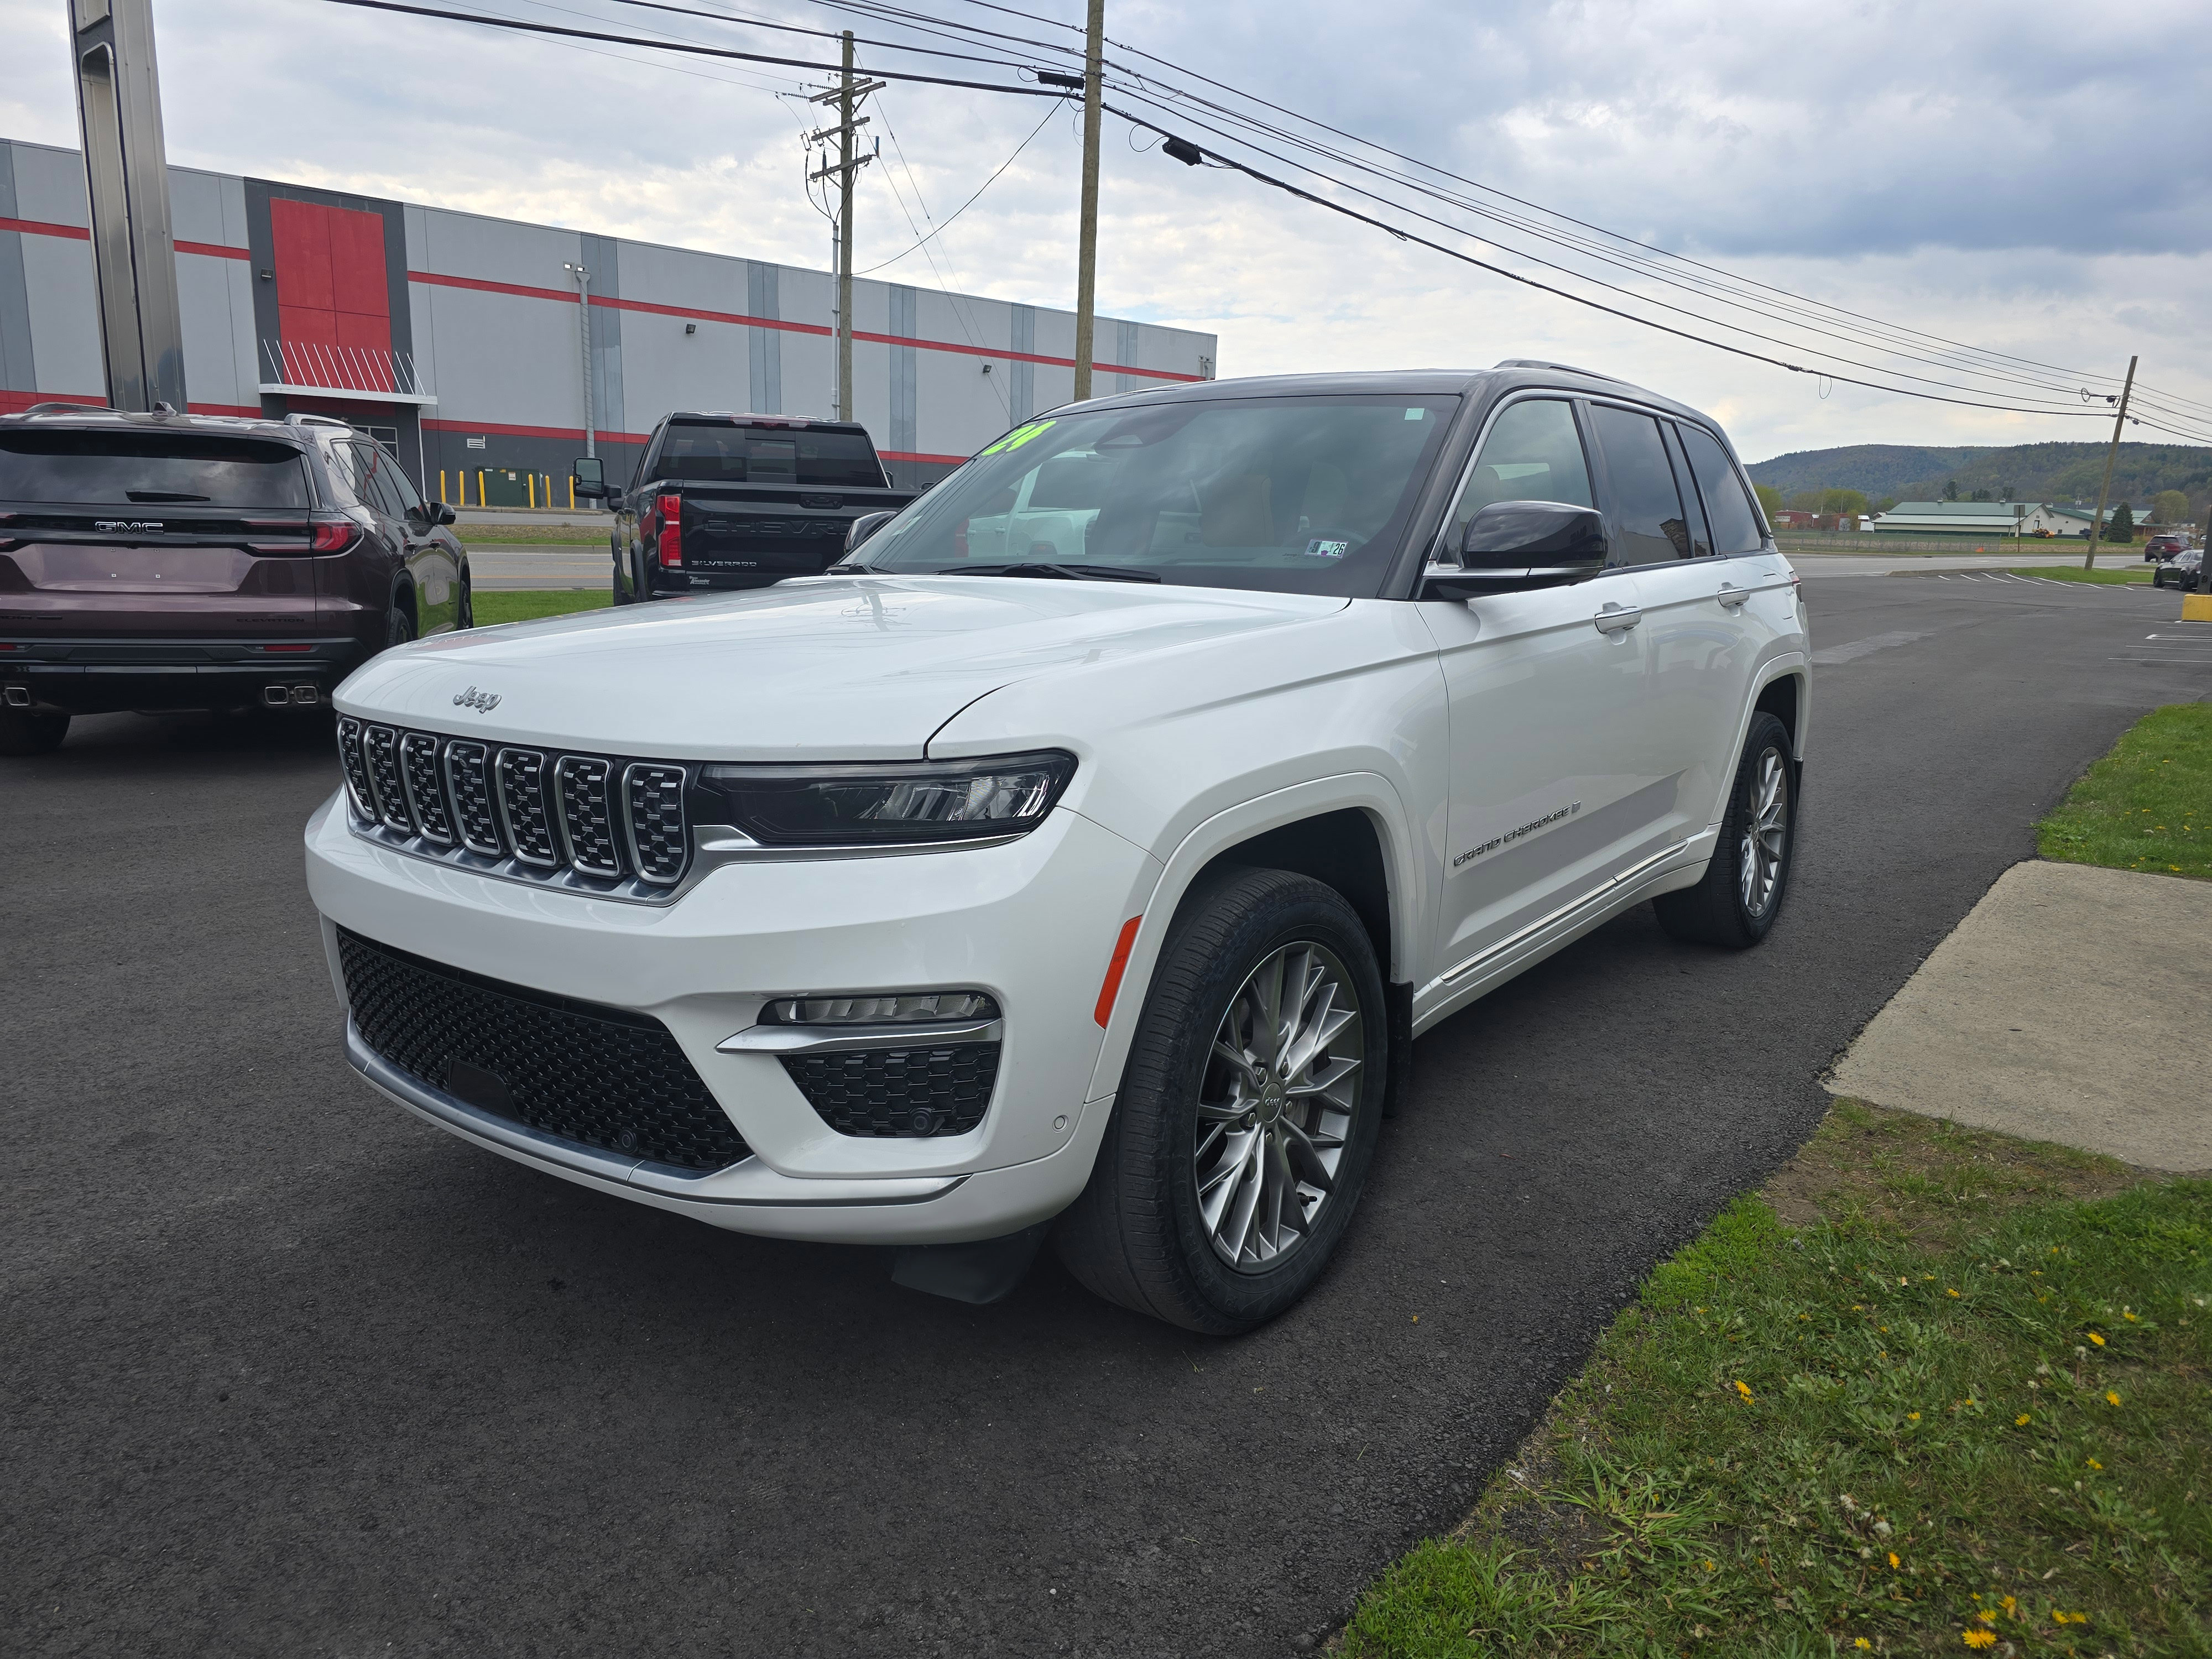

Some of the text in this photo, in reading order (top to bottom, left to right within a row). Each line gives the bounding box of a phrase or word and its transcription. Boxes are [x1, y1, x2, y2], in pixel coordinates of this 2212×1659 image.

[95, 521, 164, 535] GMC
[1333, 543, 1345, 555] 26
[453, 686, 502, 714] Jeep
[1454, 805, 1571, 867] GRAND CHEROKEE
